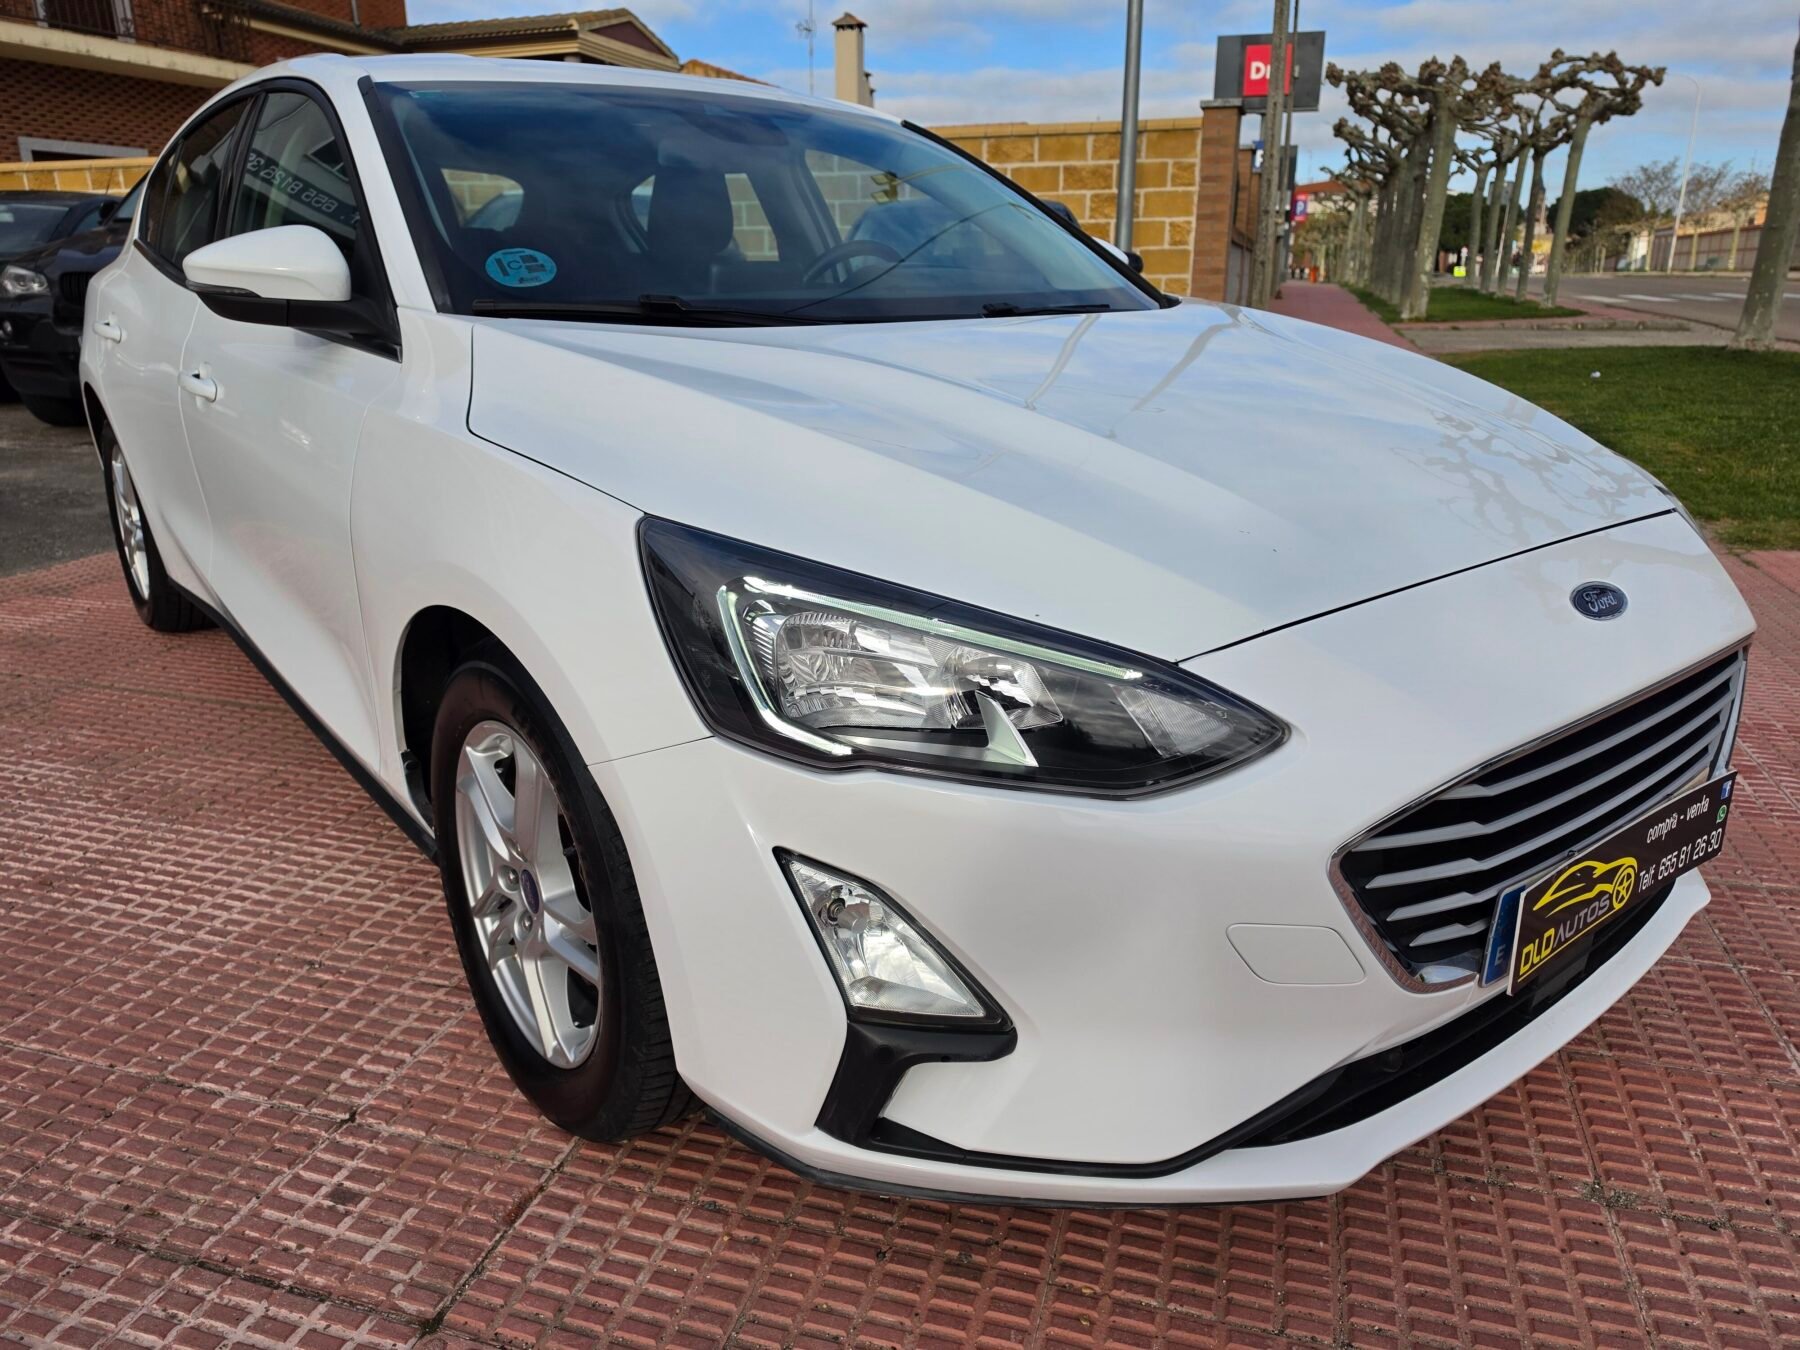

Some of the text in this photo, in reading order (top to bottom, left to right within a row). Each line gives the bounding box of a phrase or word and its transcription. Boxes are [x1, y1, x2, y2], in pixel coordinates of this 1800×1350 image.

[1583, 590, 1617, 612] Ford
[1646, 812, 1678, 844] compra
[1686, 795, 1709, 821] venta
[1658, 851, 1678, 880] 655
[1678, 843, 1692, 868] 81
[1692, 835, 1707, 861] 26
[1707, 827, 1722, 852] 30
[1494, 944, 1504, 966] E
